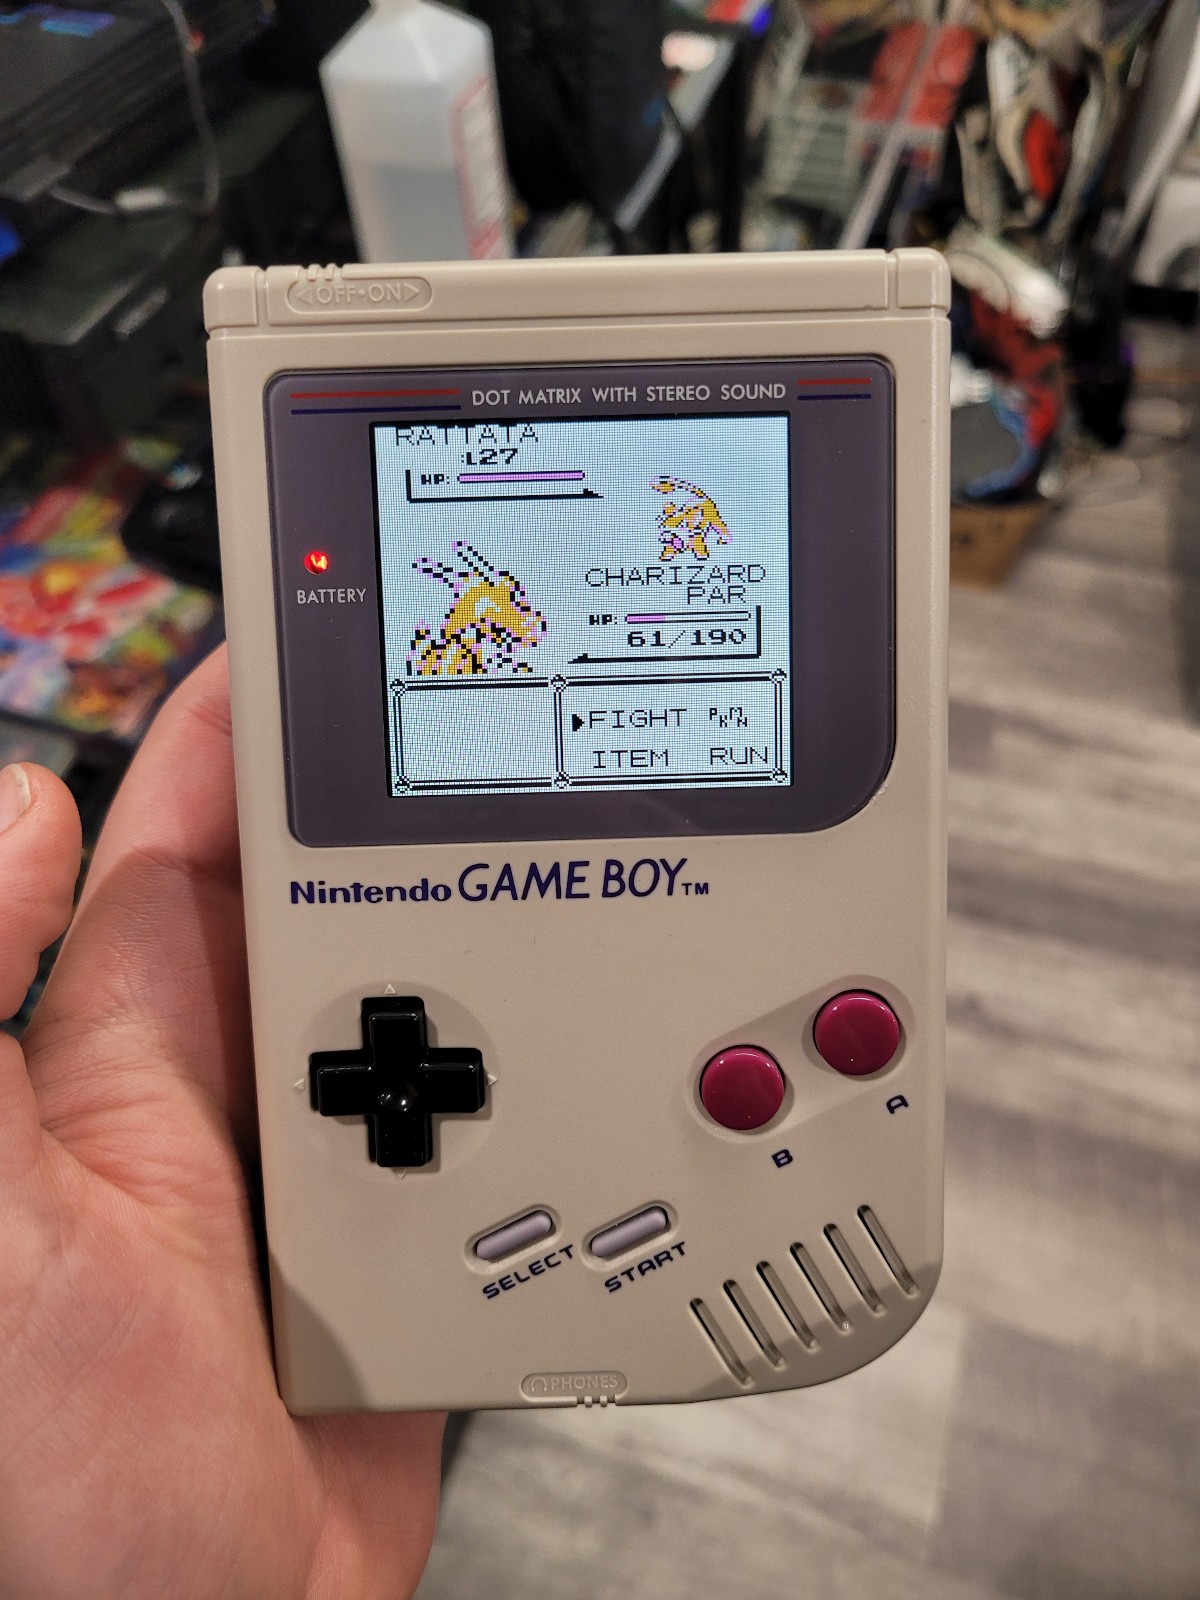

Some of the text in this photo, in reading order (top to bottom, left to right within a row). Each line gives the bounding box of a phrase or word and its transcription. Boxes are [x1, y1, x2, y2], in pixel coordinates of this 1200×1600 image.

[472, 383, 786, 406] DOT MATRIX WITH STEREO SOUND
[395, 423, 539, 446] RATTATA
[585, 564, 766, 587] CHARIZARD
[296, 588, 367, 605] BATTERY
[687, 585, 747, 605] PAR
[627, 628, 747, 649] 61/190
[589, 708, 688, 729] FIGHT
[592, 746, 768, 769] ITEM RUN
[290, 877, 452, 905] Nintendo
[457, 860, 591, 902] GAME
[886, 1094, 909, 1115] A
[771, 1148, 794, 1169] B
[482, 1243, 574, 1300] SELECT
[604, 1240, 686, 1293] START
[550, 1374, 619, 1391] PHONES
